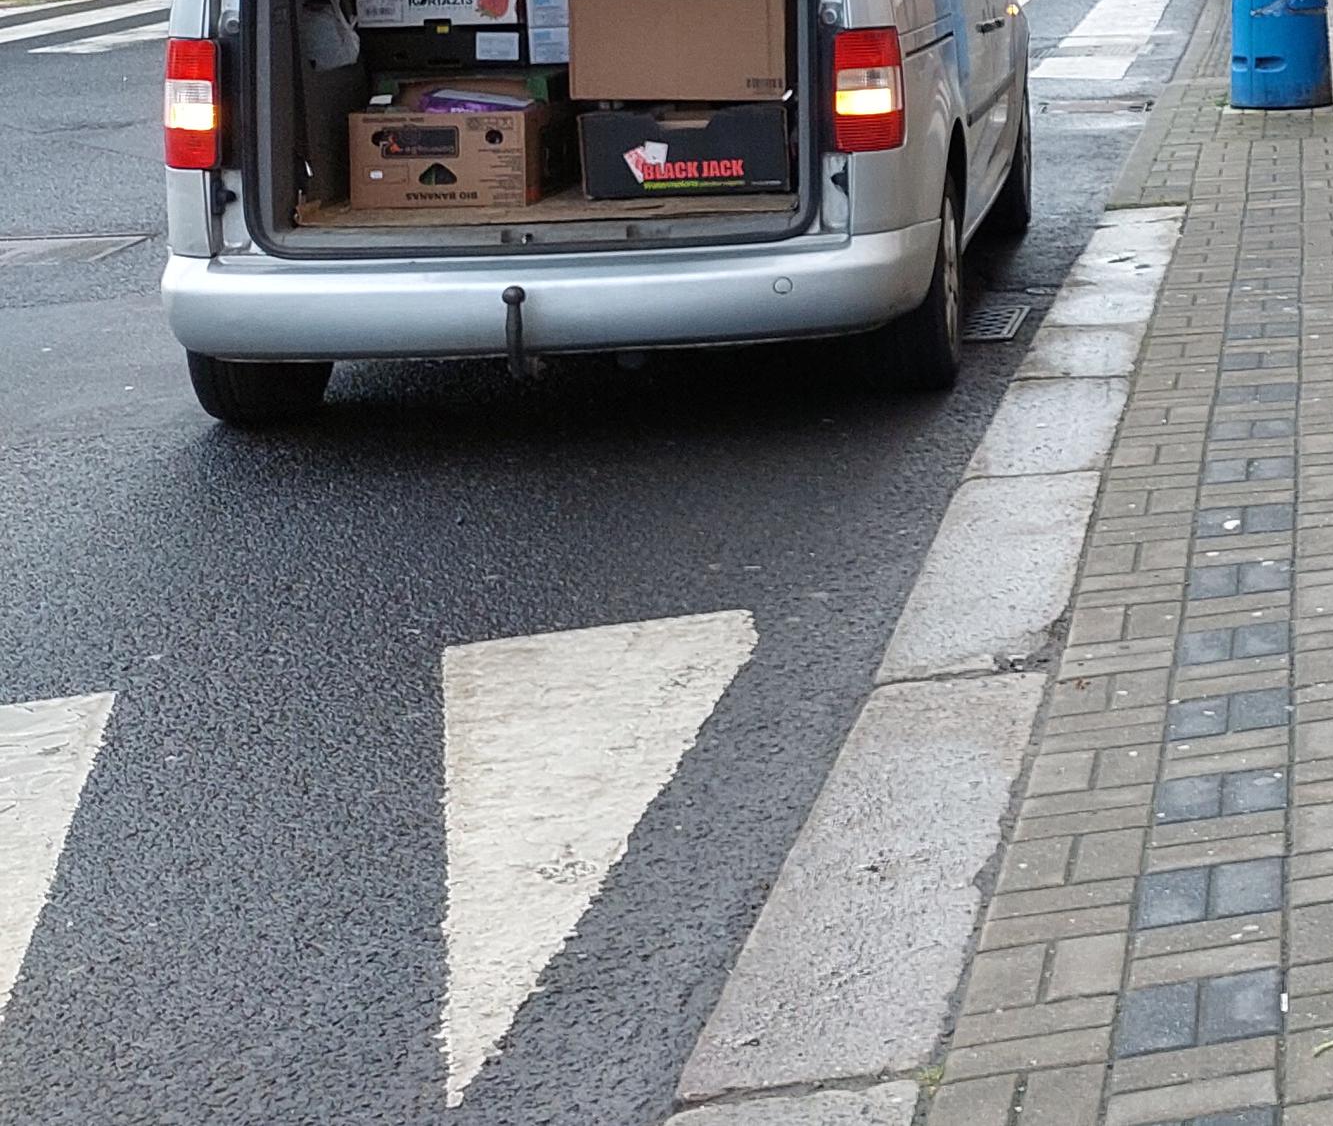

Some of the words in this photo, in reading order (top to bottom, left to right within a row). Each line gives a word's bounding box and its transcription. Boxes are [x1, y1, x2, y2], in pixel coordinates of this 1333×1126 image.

[643, 161, 699, 181] BLACK
[701, 159, 745, 178] JACK
[406, 191, 457, 201] BANANAS
[460, 191, 478, 200] BIO
